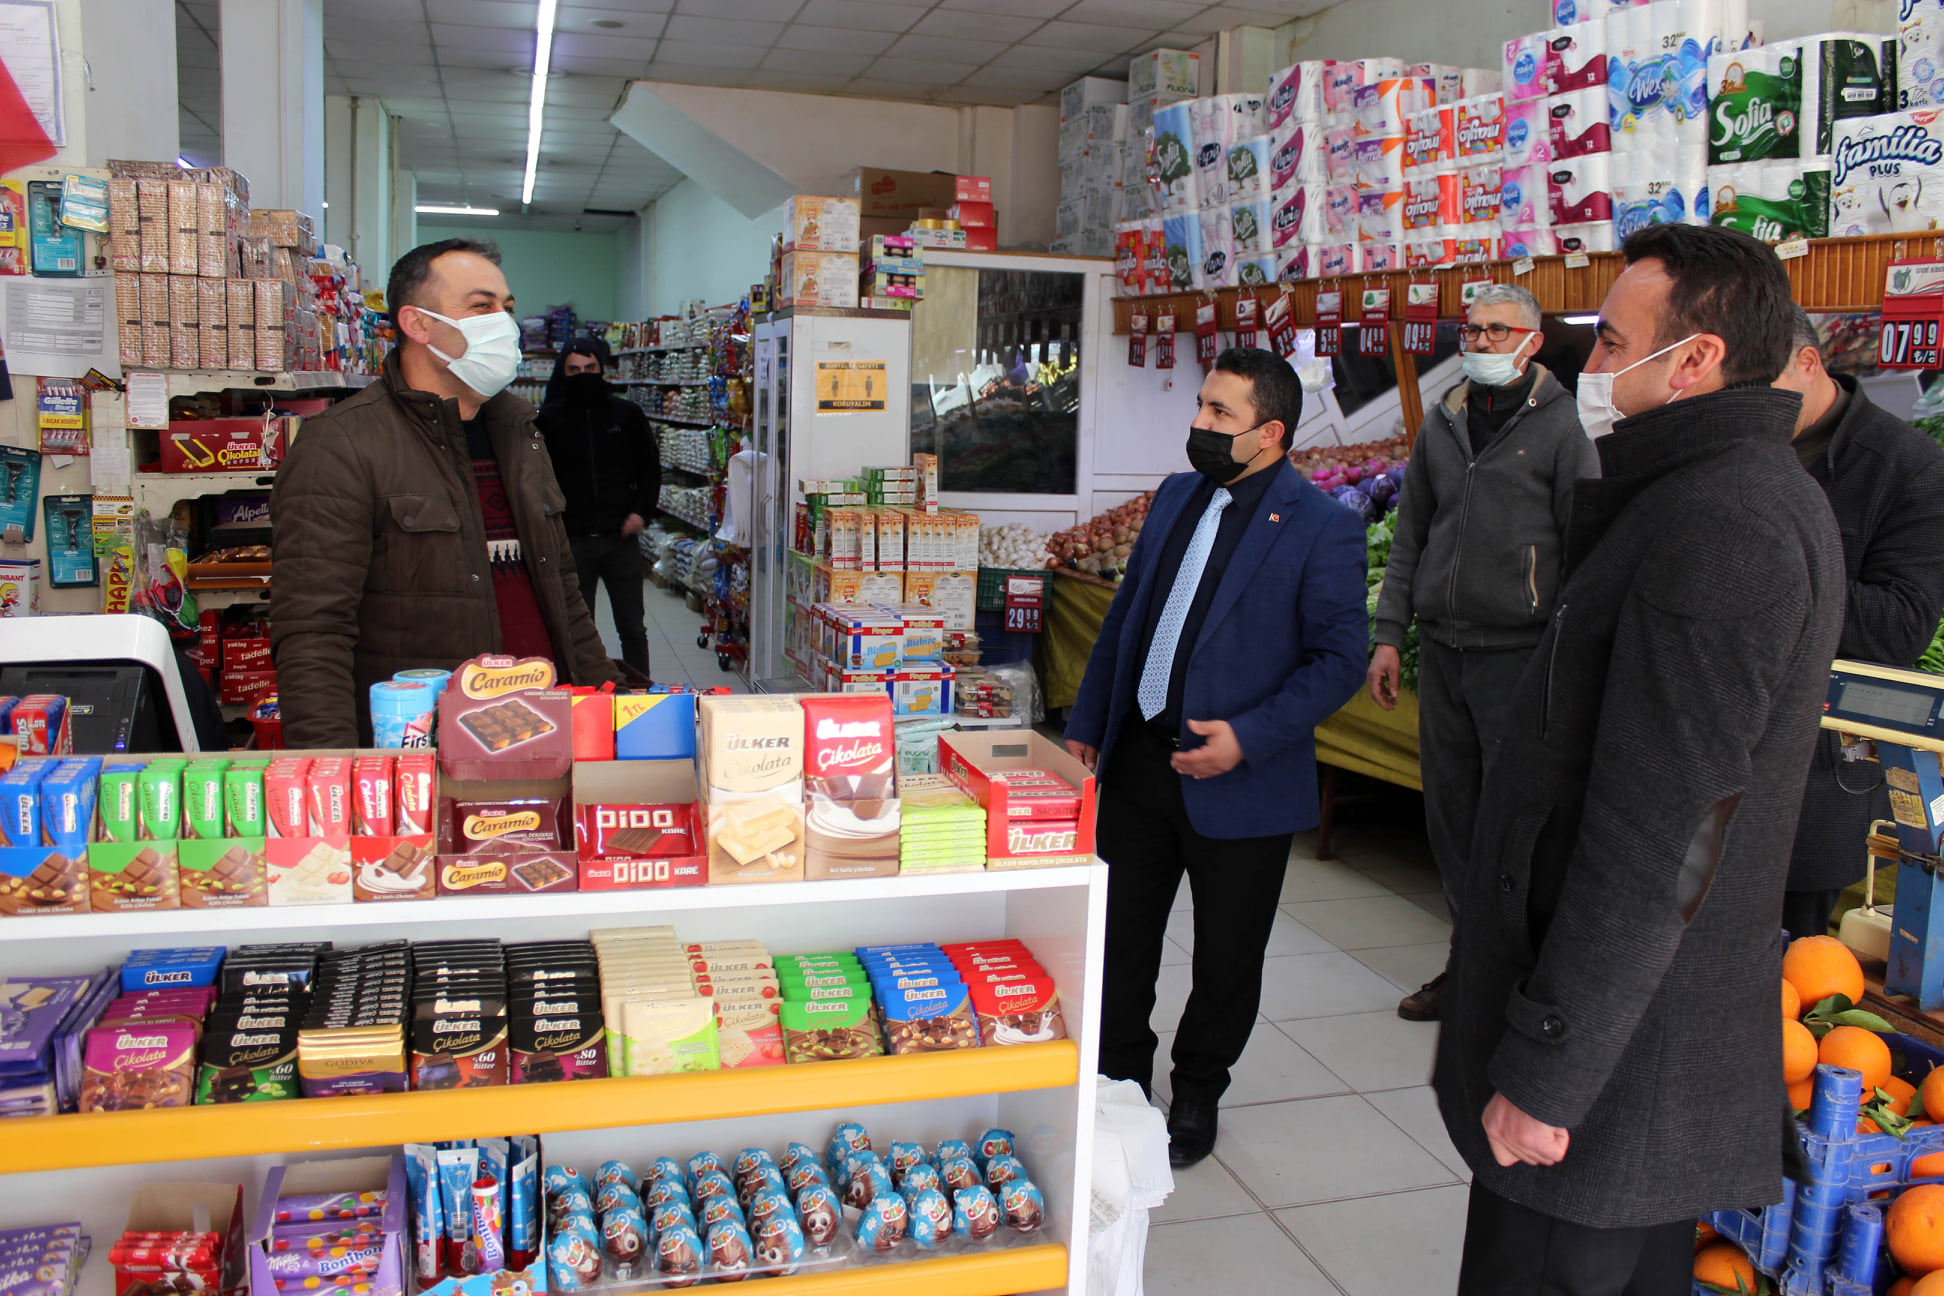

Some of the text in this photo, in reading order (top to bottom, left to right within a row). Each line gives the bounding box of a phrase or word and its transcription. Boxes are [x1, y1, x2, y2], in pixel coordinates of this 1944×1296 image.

[1662, 34, 1677, 48] 32
[1900, 90, 1908, 109] 3
[1711, 97, 1774, 147] Sofia
[1834, 124, 1943, 186] familia
[1869, 163, 1901, 178] PLUS
[1881, 323, 1937, 363] 07 99
[1008, 608, 1024, 628] 29
[470, 668, 545, 692] Caramio
[726, 735, 790, 751] ÜLKER
[817, 740, 882, 771] Çikolata
[471, 816, 534, 835] Caramio
[449, 866, 502, 884] Caramio
[674, 866, 699, 876] KARE
[710, 962, 749, 972] ÜLKER
[145, 971, 192, 984] ÜLKER
[805, 976, 847, 988] ÜLKER
[897, 977, 939, 990] ÜLKER
[716, 986, 755, 995] ÜLKER
[811, 988, 853, 1000] ÜLKER
[905, 989, 947, 1002] ÜLKER
[995, 984, 1037, 997] ÜLKER
[532, 1001, 579, 1015] ÜLKER
[805, 1002, 848, 1013] ÜLKER
[237, 1016, 285, 1030] ÜLKER
[433, 1019, 481, 1033] ÜLKER
[533, 1019, 581, 1032] ÜLKER
[116, 1034, 168, 1049] ÜLKER
[231, 1034, 280, 1047] ÜLKER
[325, 1059, 374, 1067] GODIVA
[473, 1061, 495, 1070] Bitter
[575, 1058, 597, 1067] Bitter
[269, 1073, 293, 1082] Bitter
